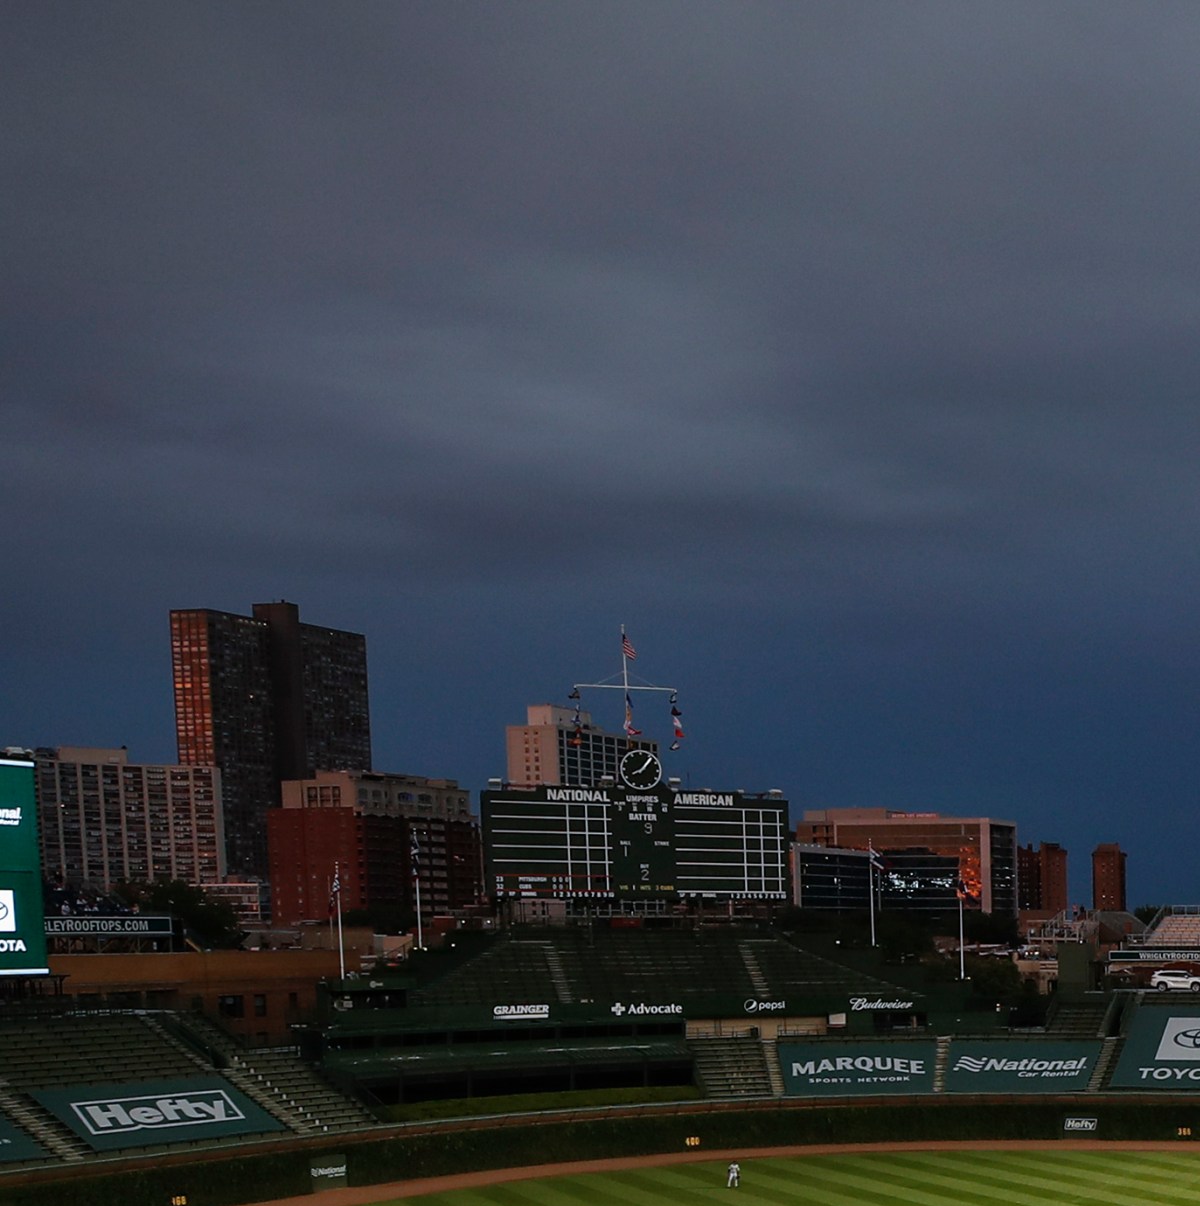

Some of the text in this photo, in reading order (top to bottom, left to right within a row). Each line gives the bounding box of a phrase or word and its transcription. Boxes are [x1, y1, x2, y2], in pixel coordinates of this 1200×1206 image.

[546, 788, 610, 802] NATIONAL
[626, 795, 659, 803] UMPIRES
[674, 794, 734, 806] AMERICAN
[629, 813, 657, 821] BATTER
[644, 823, 652, 834] 9
[641, 870, 649, 881] 2
[493, 1004, 550, 1016] GRAINGER
[628, 1002, 682, 1015] Advocate
[758, 1000, 786, 1012] pepsi
[850, 997, 912, 1011] Budweiser
[792, 1056, 926, 1077] MARQUEE
[809, 1075, 910, 1084] SPORTS NETWORK
[1018, 1070, 1080, 1078] Car Rental
[85, 1099, 227, 1129] Hefty
[1066, 1120, 1095, 1130] Hefty
